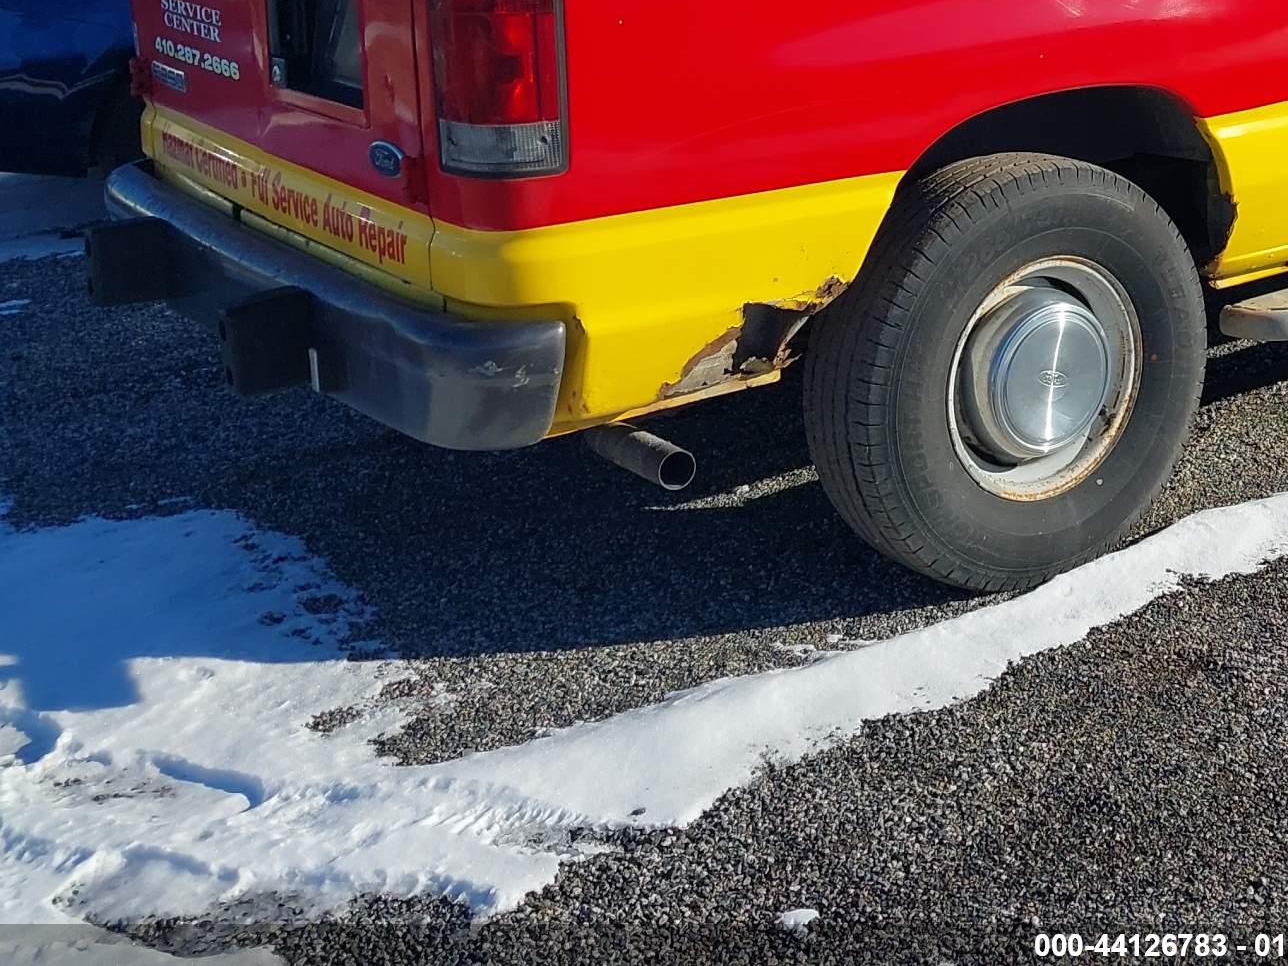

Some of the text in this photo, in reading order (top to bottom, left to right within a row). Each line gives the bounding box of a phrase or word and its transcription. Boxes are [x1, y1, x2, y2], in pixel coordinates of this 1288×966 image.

[164, 11, 221, 43] CENTER
[155, 36, 240, 80] 410.287.2666
[374, 147, 396, 171] Ford
[271, 171, 318, 227] Service
[323, 194, 353, 242] Auto
[358, 207, 408, 264] Repair
